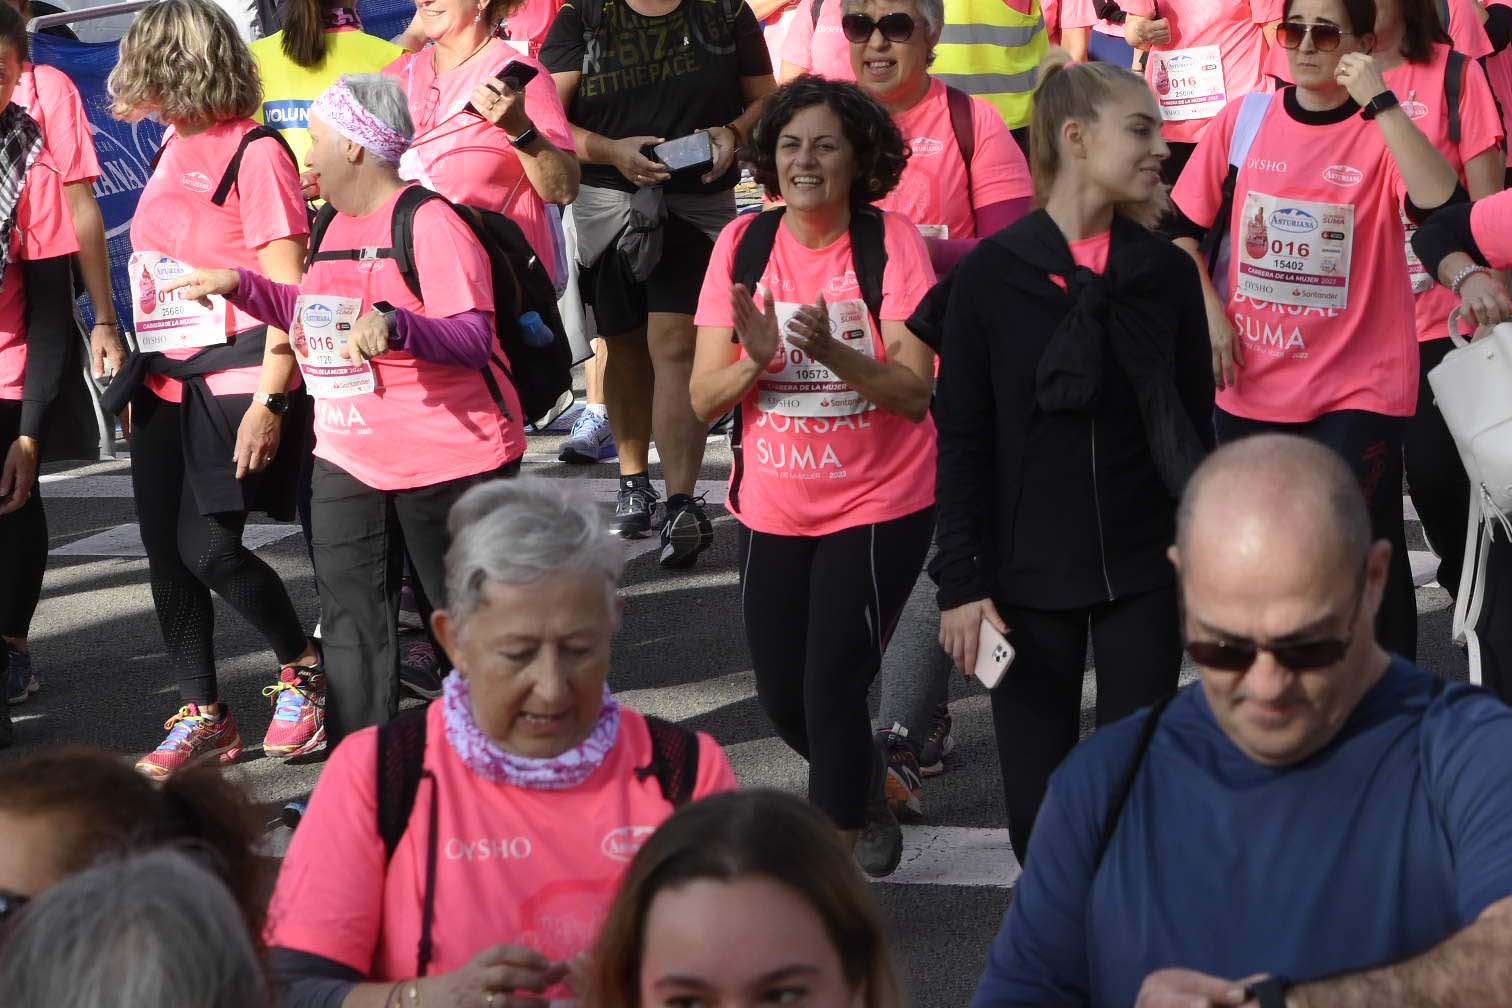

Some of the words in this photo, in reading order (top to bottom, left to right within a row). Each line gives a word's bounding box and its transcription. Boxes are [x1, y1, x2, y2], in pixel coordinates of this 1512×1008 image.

[1171, 76, 1197, 88] 016
[1247, 158, 1287, 173] OYSHO
[1271, 214, 1314, 229] ASTURIANA
[1323, 217, 1345, 225] SUMA
[1271, 239, 1310, 257] 016
[1273, 258, 1304, 271] 15402
[1247, 267, 1274, 280] CARRERA
[1274, 271, 1285, 280] DE
[1285, 273, 1295, 281] LA
[1296, 274, 1319, 284] MUJER
[1244, 281, 1274, 294] OYSHO
[1301, 288, 1338, 300] Santander
[1234, 313, 1306, 351] SUMA
[309, 336, 334, 351] 016
[795, 369, 829, 380] 10573
[799, 382, 810, 391] DE
[811, 383, 821, 391] LA
[822, 383, 847, 391] MUJER
[757, 438, 843, 470] SUMA
[446, 836, 532, 861] OYSHO
